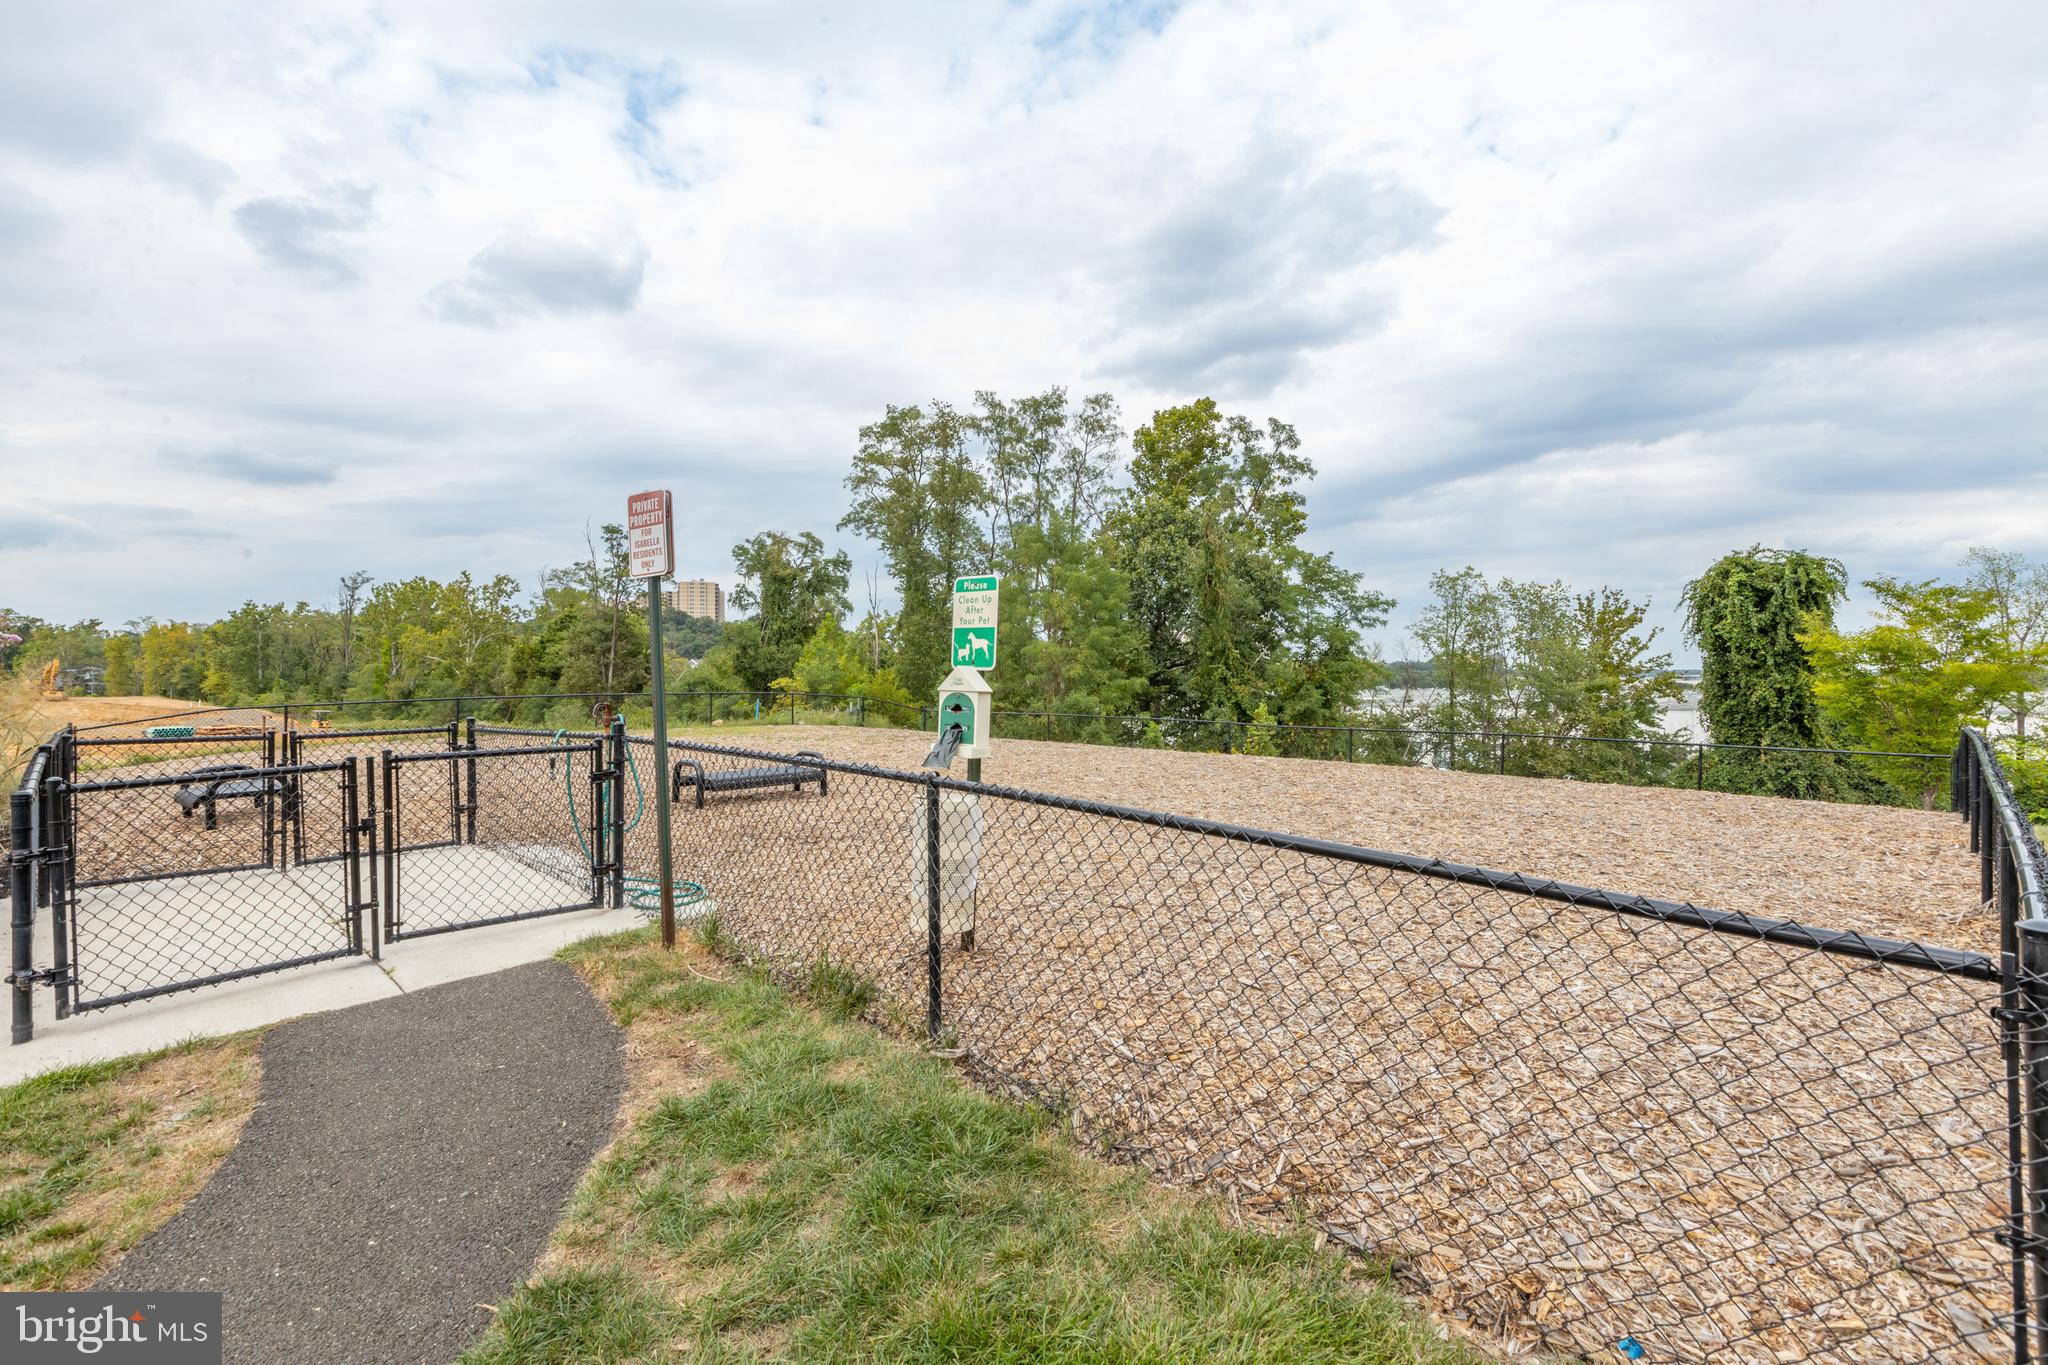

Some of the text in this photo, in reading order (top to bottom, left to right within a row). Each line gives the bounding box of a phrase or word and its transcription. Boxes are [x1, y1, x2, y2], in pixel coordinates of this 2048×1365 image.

[632, 498, 659, 513] PRIVATE
[630, 511, 663, 527] PROPERTY
[641, 528, 652, 537] FOR
[634, 537, 660, 549] ISABELLA
[633, 548, 663, 559] RESIDENTS
[641, 560, 655, 569] ONLY
[963, 581, 988, 590] Please
[958, 595, 992, 604] Clean Up
[965, 606, 984, 614] After
[959, 616, 990, 625] Your Pet
